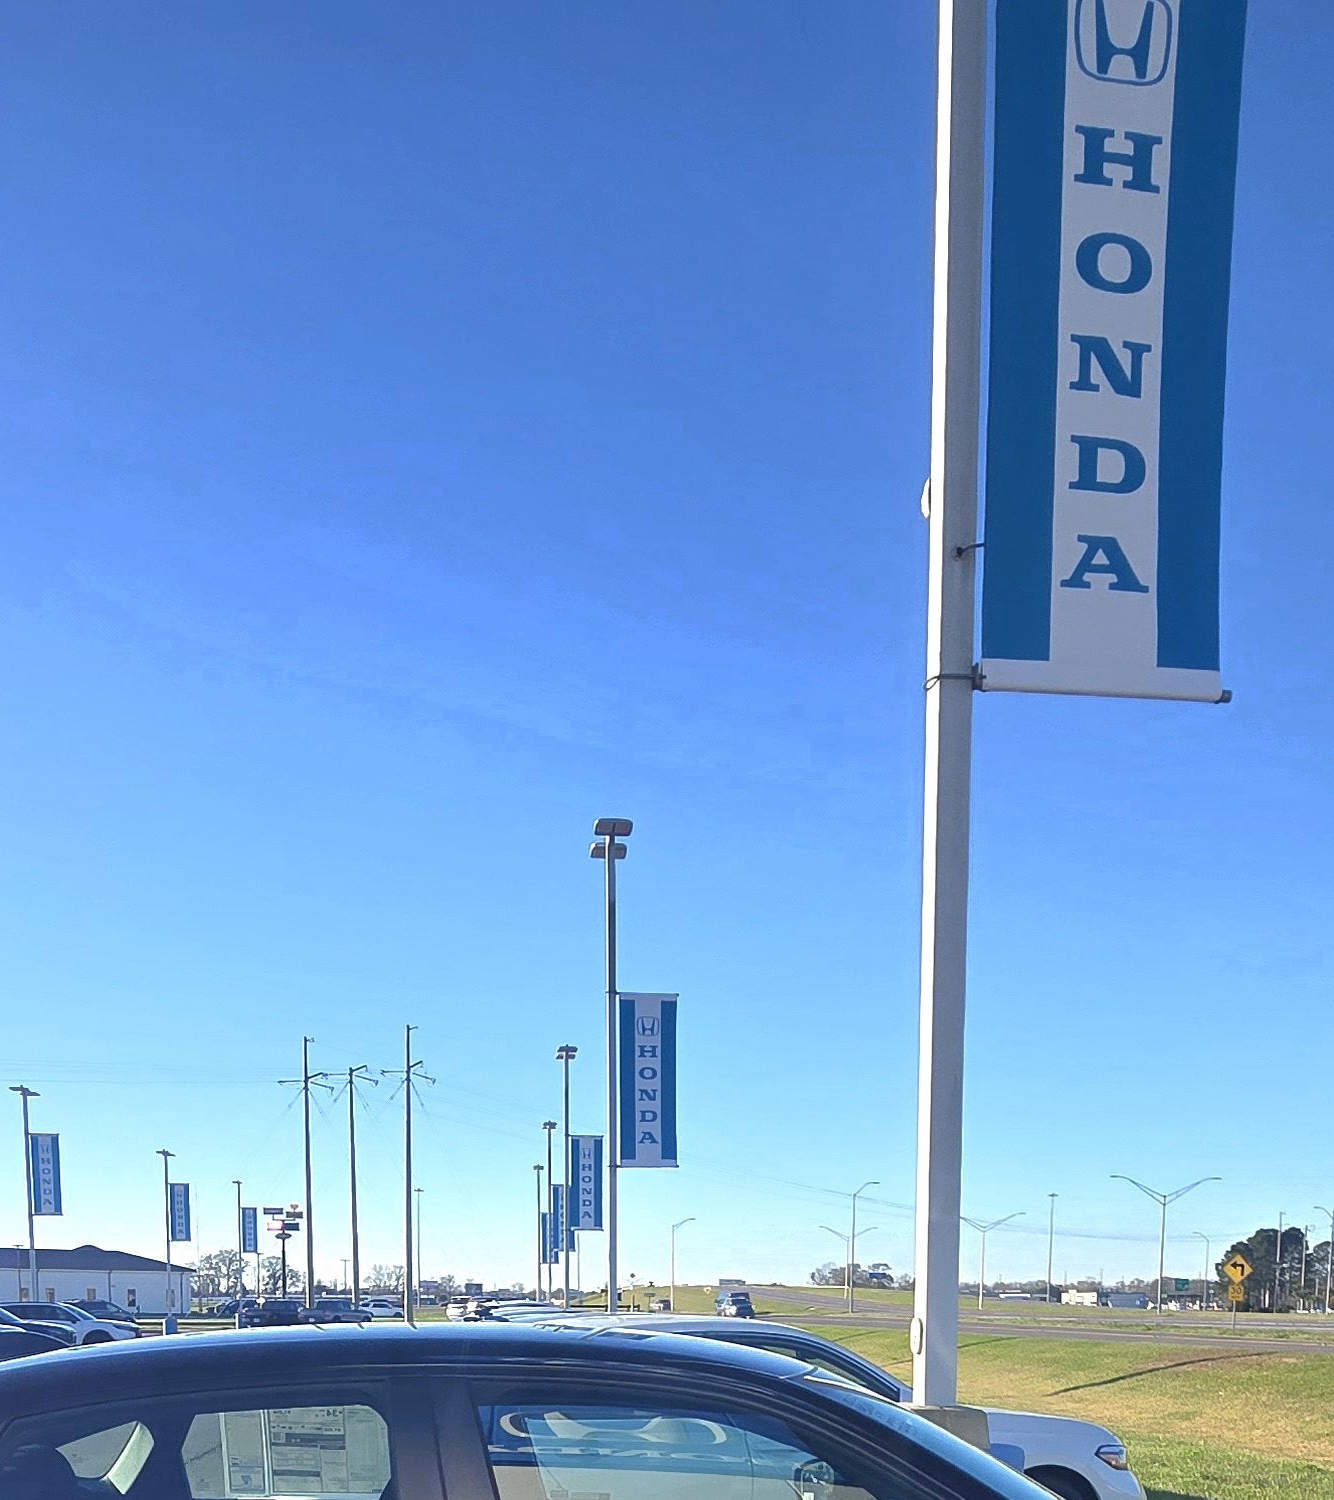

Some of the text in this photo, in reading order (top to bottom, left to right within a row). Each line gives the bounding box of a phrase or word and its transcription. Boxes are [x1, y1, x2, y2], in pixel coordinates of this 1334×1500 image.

[1060, 124, 1163, 594] HONDA
[637, 1044, 659, 1144] HONDA
[40, 1157, 52, 1206] HONDA
[581, 1163, 593, 1219] HONDA
